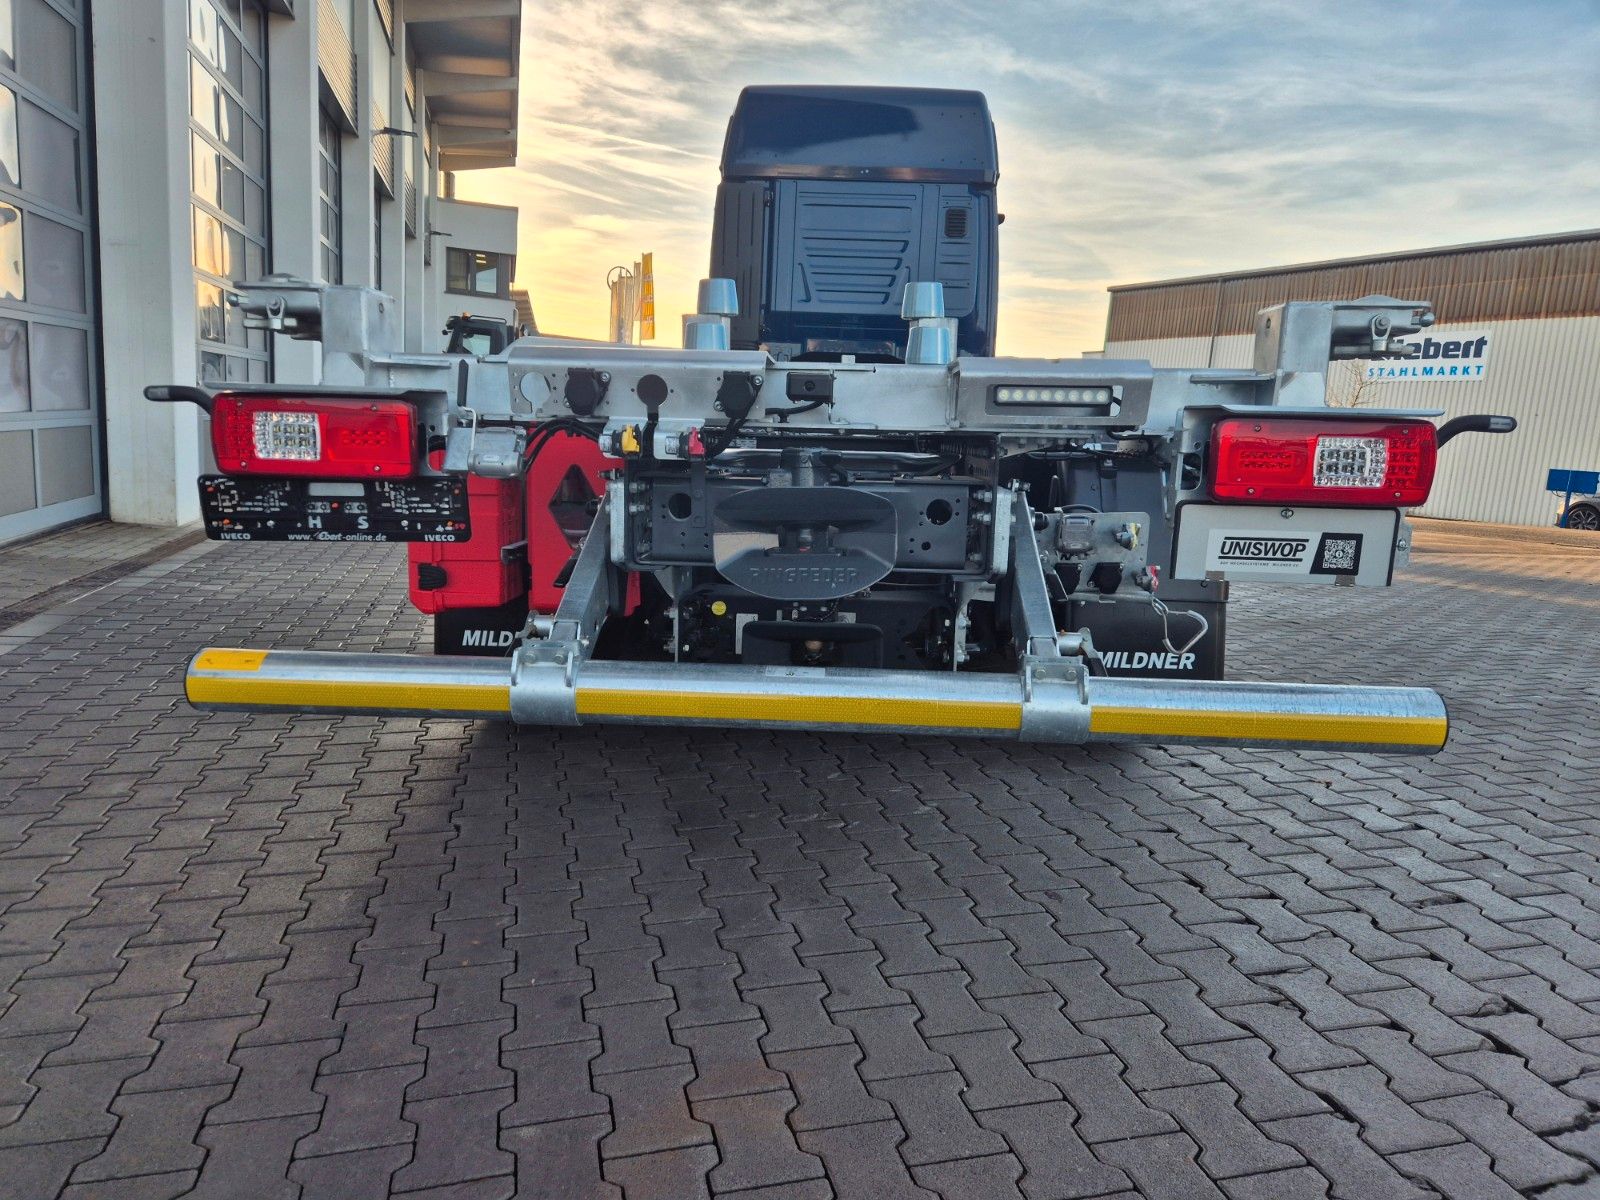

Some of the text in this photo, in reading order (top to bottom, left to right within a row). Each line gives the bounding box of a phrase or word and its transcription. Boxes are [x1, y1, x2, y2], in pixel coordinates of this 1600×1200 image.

[1371, 335, 1488, 360] ebert
[1368, 365, 1484, 377] STAHLMARKT
[220, 532, 251, 540] IVECO
[424, 534, 455, 542] IVECO
[1220, 540, 1307, 558] UNISWOP
[462, 629, 521, 647] MILD
[1098, 651, 1196, 670] MILDNER
